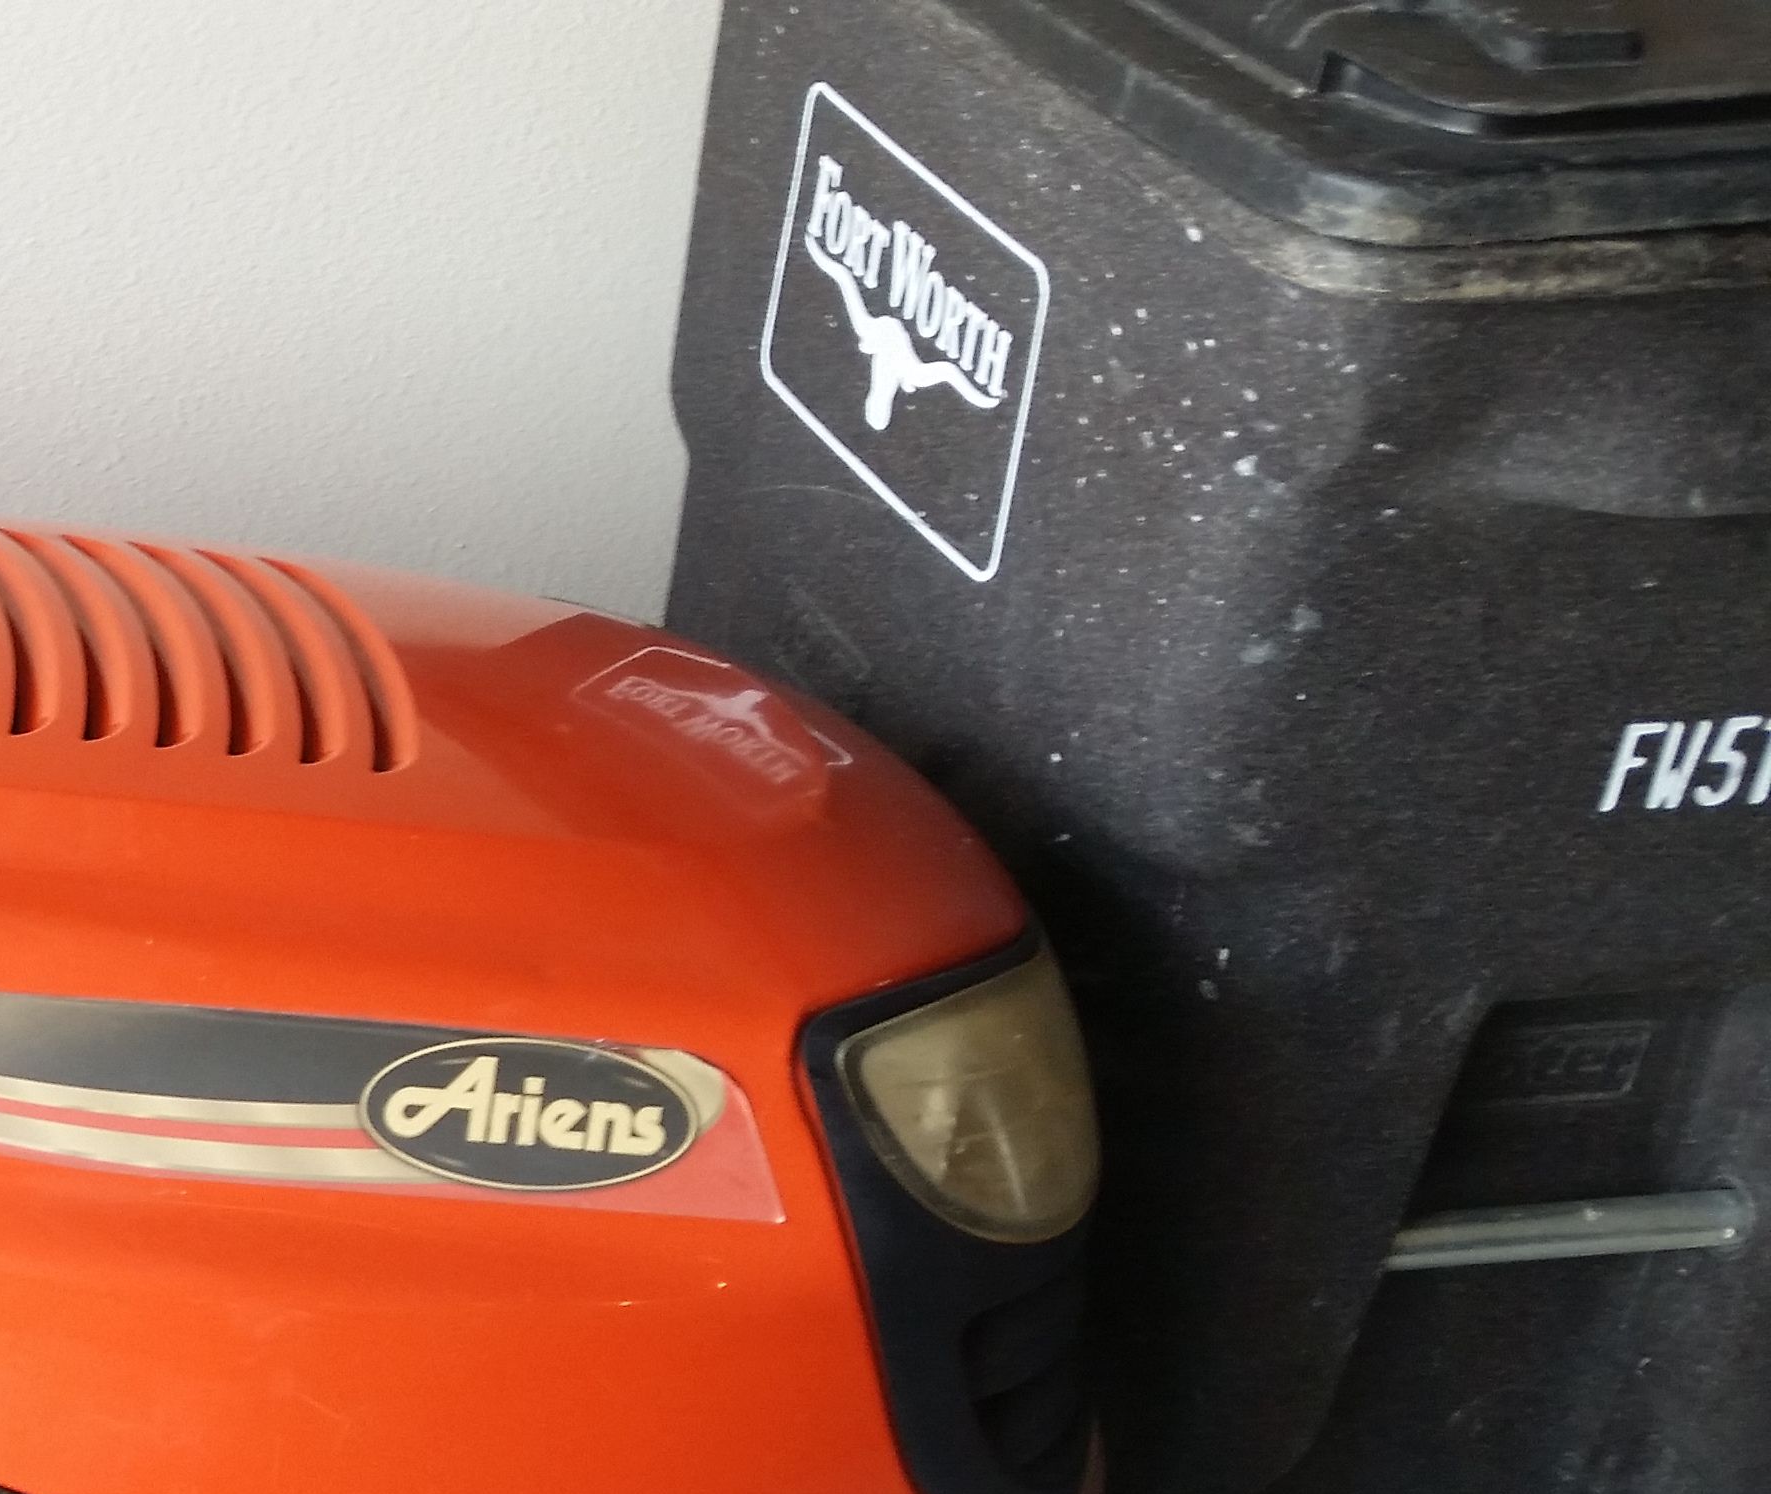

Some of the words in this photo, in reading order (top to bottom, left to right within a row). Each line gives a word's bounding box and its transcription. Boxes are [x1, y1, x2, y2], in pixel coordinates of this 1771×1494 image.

[807, 154, 892, 289] FORT
[888, 219, 1015, 397] WORTH
[384, 1054, 667, 1157] Ariens
